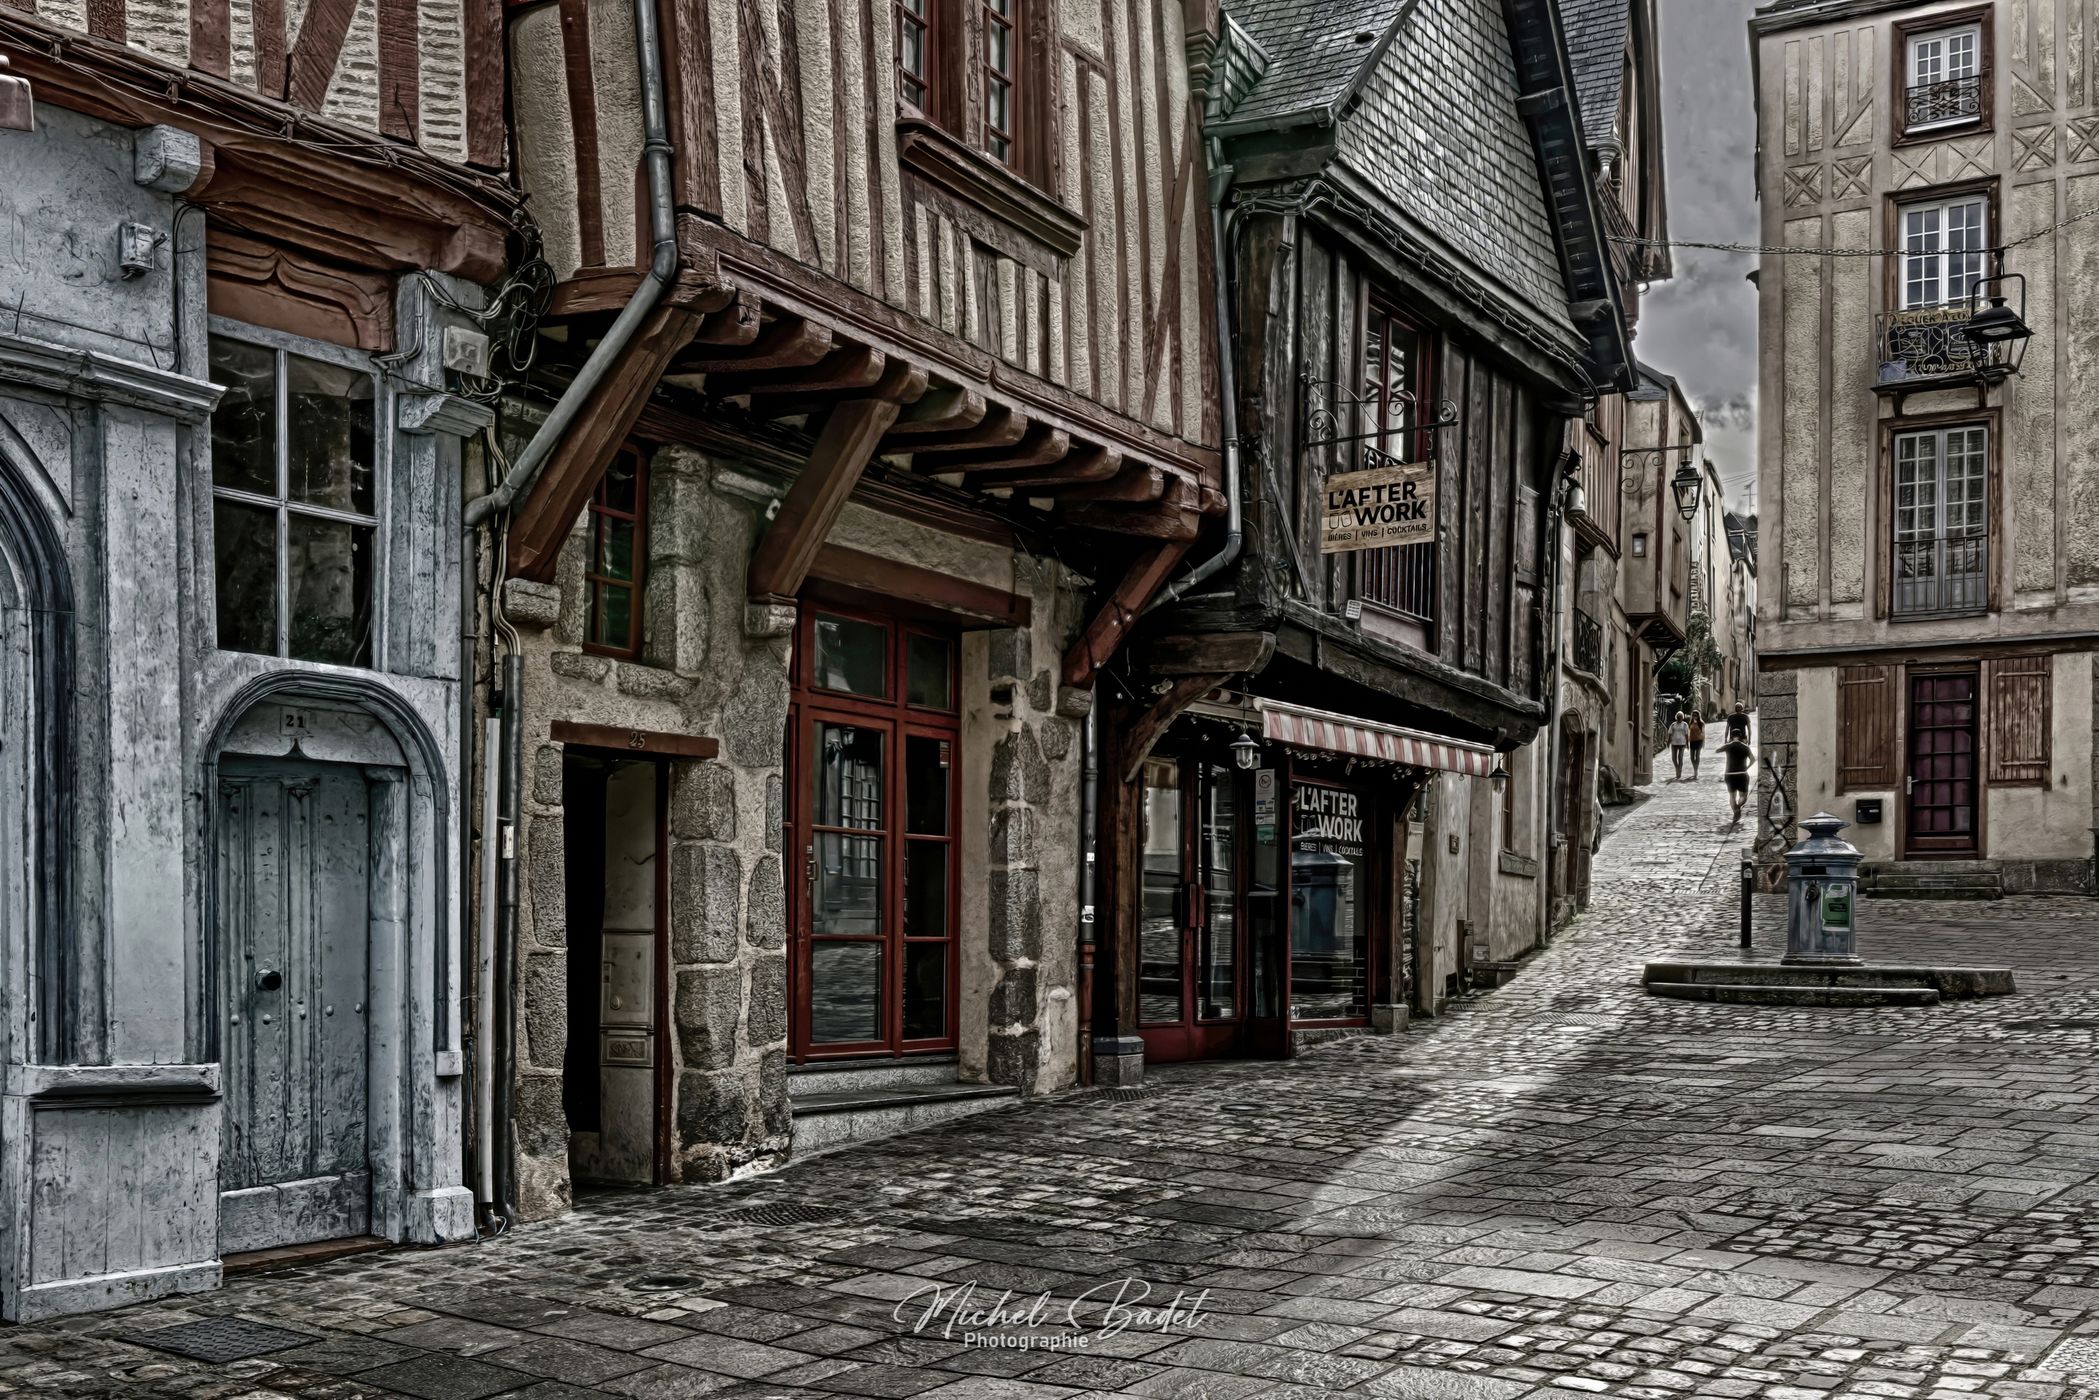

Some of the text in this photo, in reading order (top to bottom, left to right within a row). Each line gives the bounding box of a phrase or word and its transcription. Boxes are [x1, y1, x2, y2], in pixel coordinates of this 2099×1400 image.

[1329, 481, 1417, 510] L'AFTER
[1354, 500, 1427, 526] WORK
[1361, 530, 1378, 538] VINS
[1386, 523, 1428, 535] COCKTAILS
[286, 714, 305, 729] 21
[629, 731, 646, 749] 25
[1301, 786, 1357, 817] L'AFTER
[1317, 814, 1363, 842] WORK
